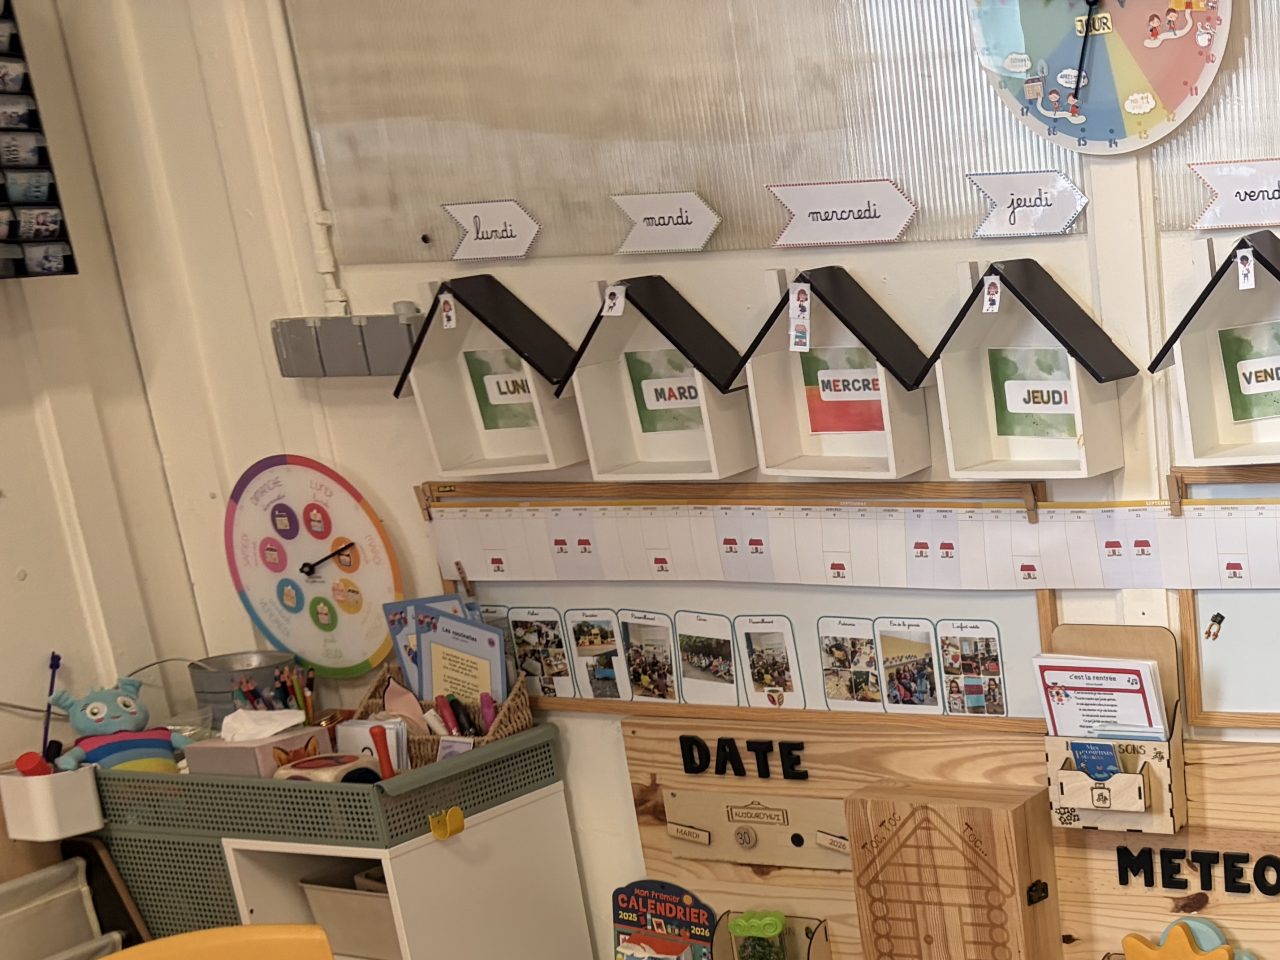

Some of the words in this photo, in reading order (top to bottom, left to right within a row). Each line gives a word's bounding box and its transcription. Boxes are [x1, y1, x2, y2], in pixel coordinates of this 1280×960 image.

[807, 200, 881, 222] mercredi
[1006, 188, 1052, 225] jeudi
[642, 208, 693, 226] mardi
[473, 215, 517, 241] lundi
[496, 379, 531, 396] LUN
[820, 378, 880, 392] MERCRE
[653, 385, 698, 402] MARD
[1022, 389, 1068, 405] JEUDI
[1118, 744, 1146, 755] SONS
[679, 735, 809, 780] DATE
[734, 810, 782, 822] AUJOURD'HUI
[676, 828, 700, 840] MARDI
[736, 832, 751, 846] 30
[829, 838, 848, 850] 2026
[634, 888, 650, 897] Mon
[618, 893, 710, 926] CALENDRIER
[618, 911, 638, 922] 2025
[690, 925, 711, 938] 2026
